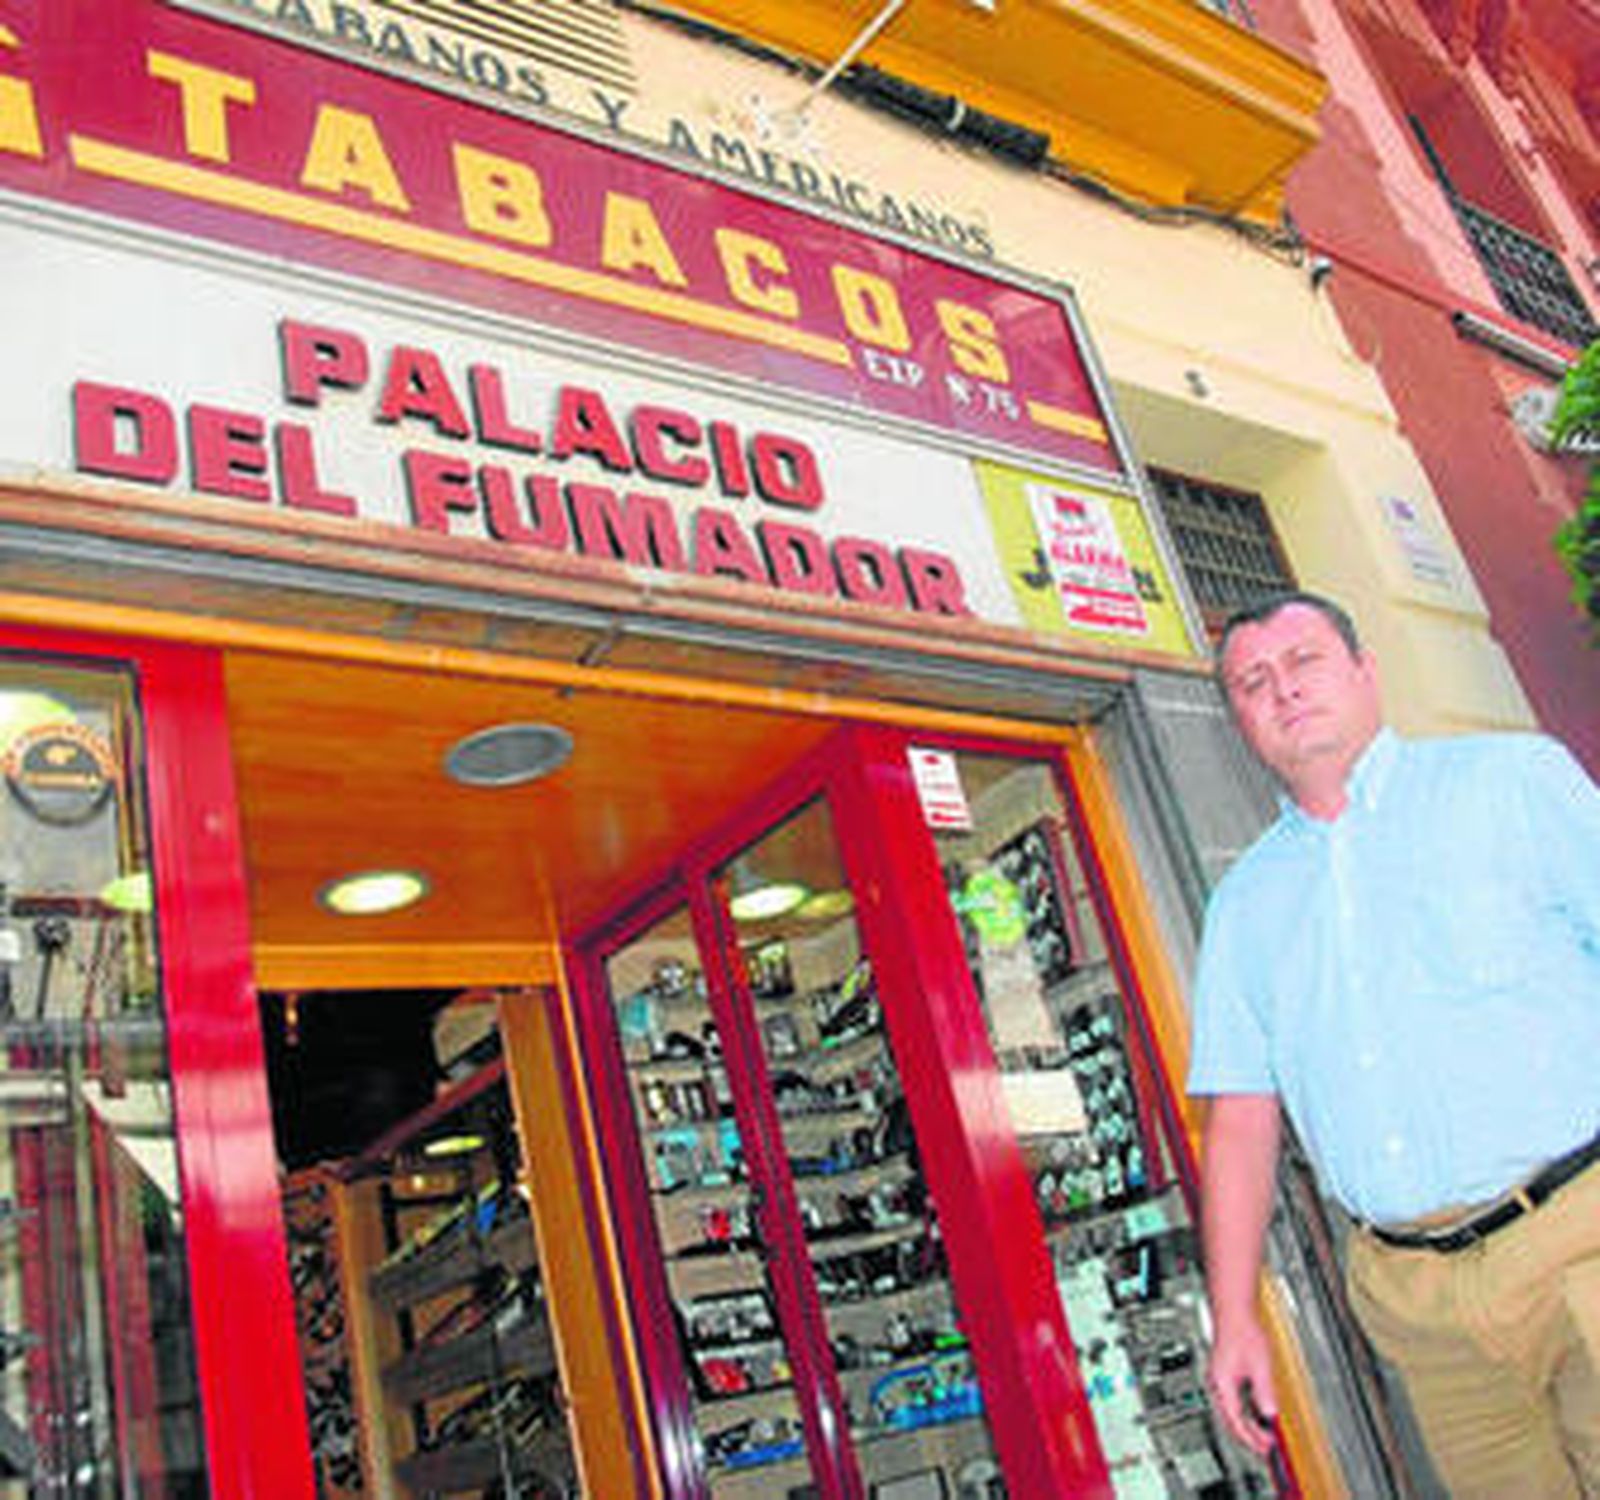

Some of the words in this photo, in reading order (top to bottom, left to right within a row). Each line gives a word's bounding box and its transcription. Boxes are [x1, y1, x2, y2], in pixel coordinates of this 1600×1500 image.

[146, 48, 1010, 384] TABACOS
[240, 0, 549, 105] ABANOS
[592, 91, 627, 130] Y
[668, 118, 994, 257] AMERICANOS
[73, 379, 358, 518] DEL
[402, 449, 974, 616] FUMADOR
[277, 318, 825, 511] PALACIO
